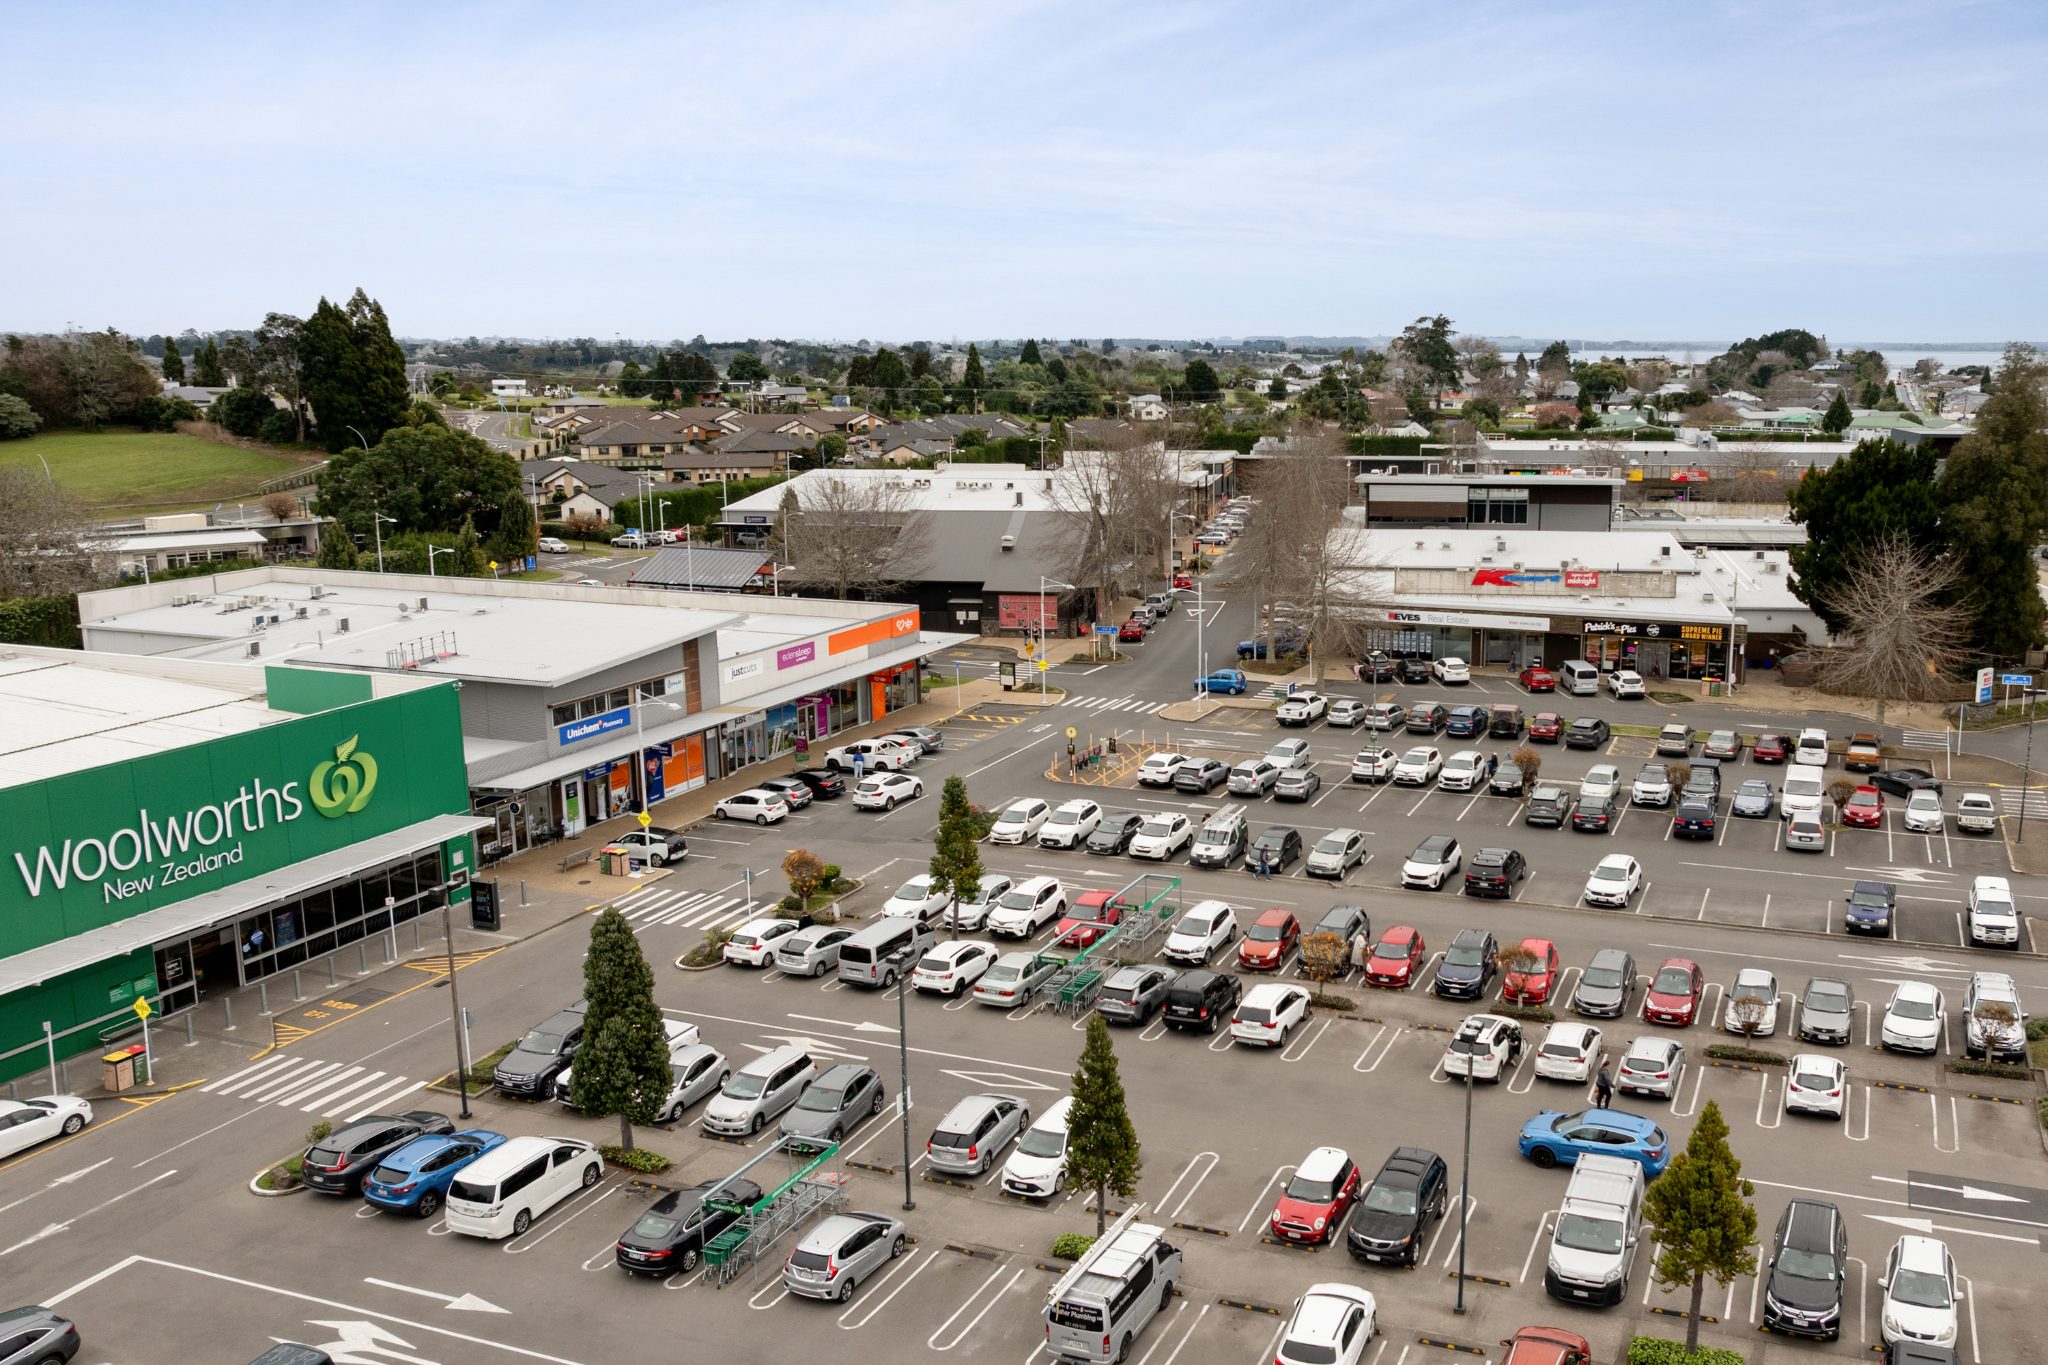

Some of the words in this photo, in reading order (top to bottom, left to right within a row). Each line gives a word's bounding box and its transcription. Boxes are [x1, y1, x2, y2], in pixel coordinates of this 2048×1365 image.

[1567, 577, 1597, 586] midnight
[1427, 615, 1444, 623] Real
[1446, 616, 1470, 624] Estate
[1585, 622, 1615, 633] Patrick's
[1620, 624, 1637, 634] Pies
[1681, 626, 1711, 634] SUPREME
[1712, 627, 1723, 635] PIE
[567, 722, 599, 739] Unichem
[14, 777, 303, 897] Woolworths
[103, 874, 155, 904] New
[160, 842, 243, 887] Zealand
[1071, 1311, 1096, 1323] Plumbing
